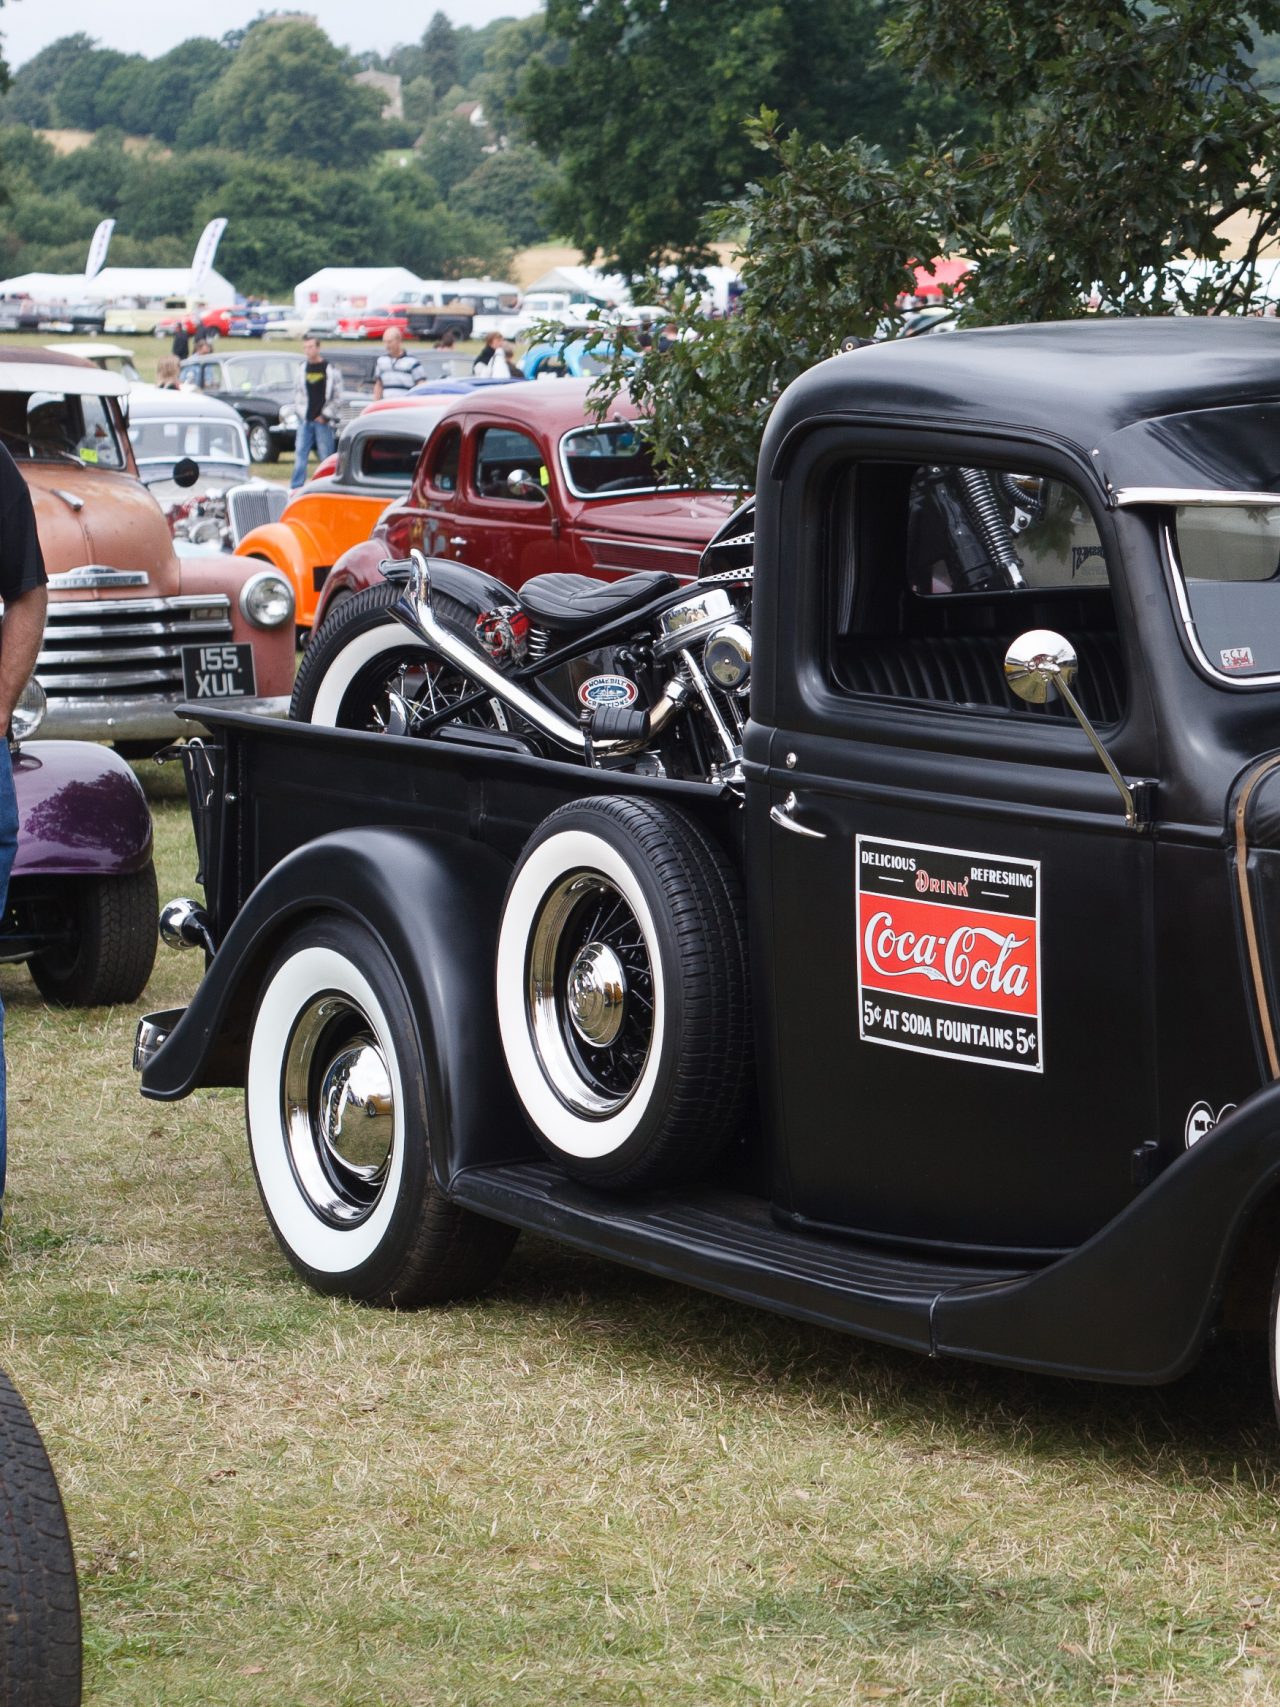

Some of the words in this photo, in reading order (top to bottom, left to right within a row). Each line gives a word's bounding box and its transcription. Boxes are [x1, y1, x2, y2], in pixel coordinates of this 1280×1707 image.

[200, 647, 239, 671] 155
[196, 672, 244, 697] XUL
[861, 851, 916, 871] DELICIOUS
[970, 867, 1033, 888] REFRESHING
[864, 911, 1030, 997] Coca-Cola
[863, 1000, 881, 1026] 5¢
[883, 1008, 899, 1030] AT
[901, 1011, 932, 1037] SODA
[936, 1018, 1013, 1050] FOUNTAINS
[1016, 1028, 1036, 1054] 5¢
